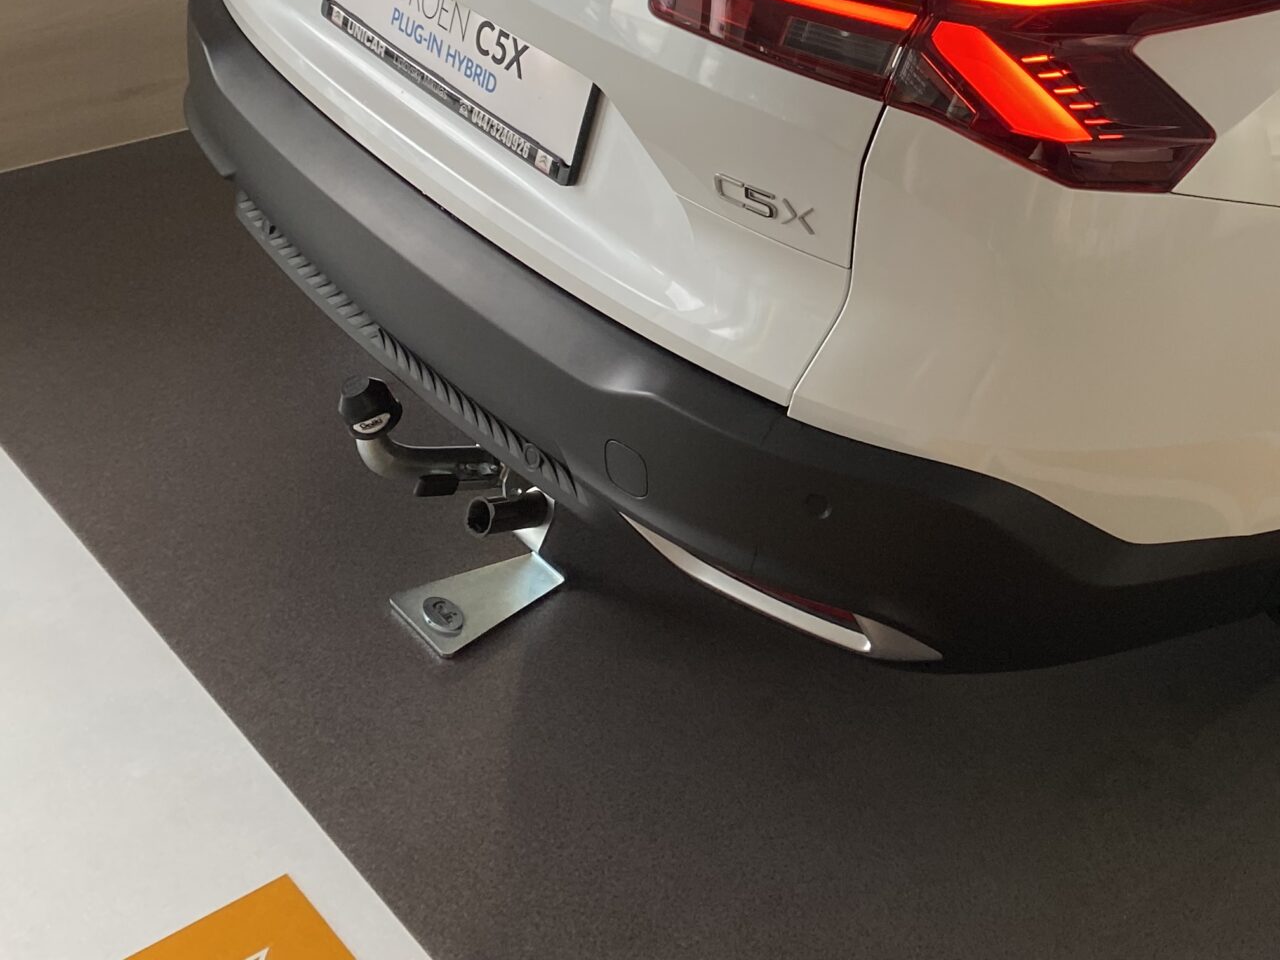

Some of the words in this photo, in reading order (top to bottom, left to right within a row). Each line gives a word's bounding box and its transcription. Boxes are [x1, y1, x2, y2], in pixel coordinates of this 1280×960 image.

[391, 7, 443, 58] PLUG-IN
[445, 44, 497, 93] HYBRID
[475, 20, 530, 80] C5X
[346, 19, 386, 57] UNICAR
[471, 107, 531, 159] 044/3240926
[714, 173, 815, 235] C5X
